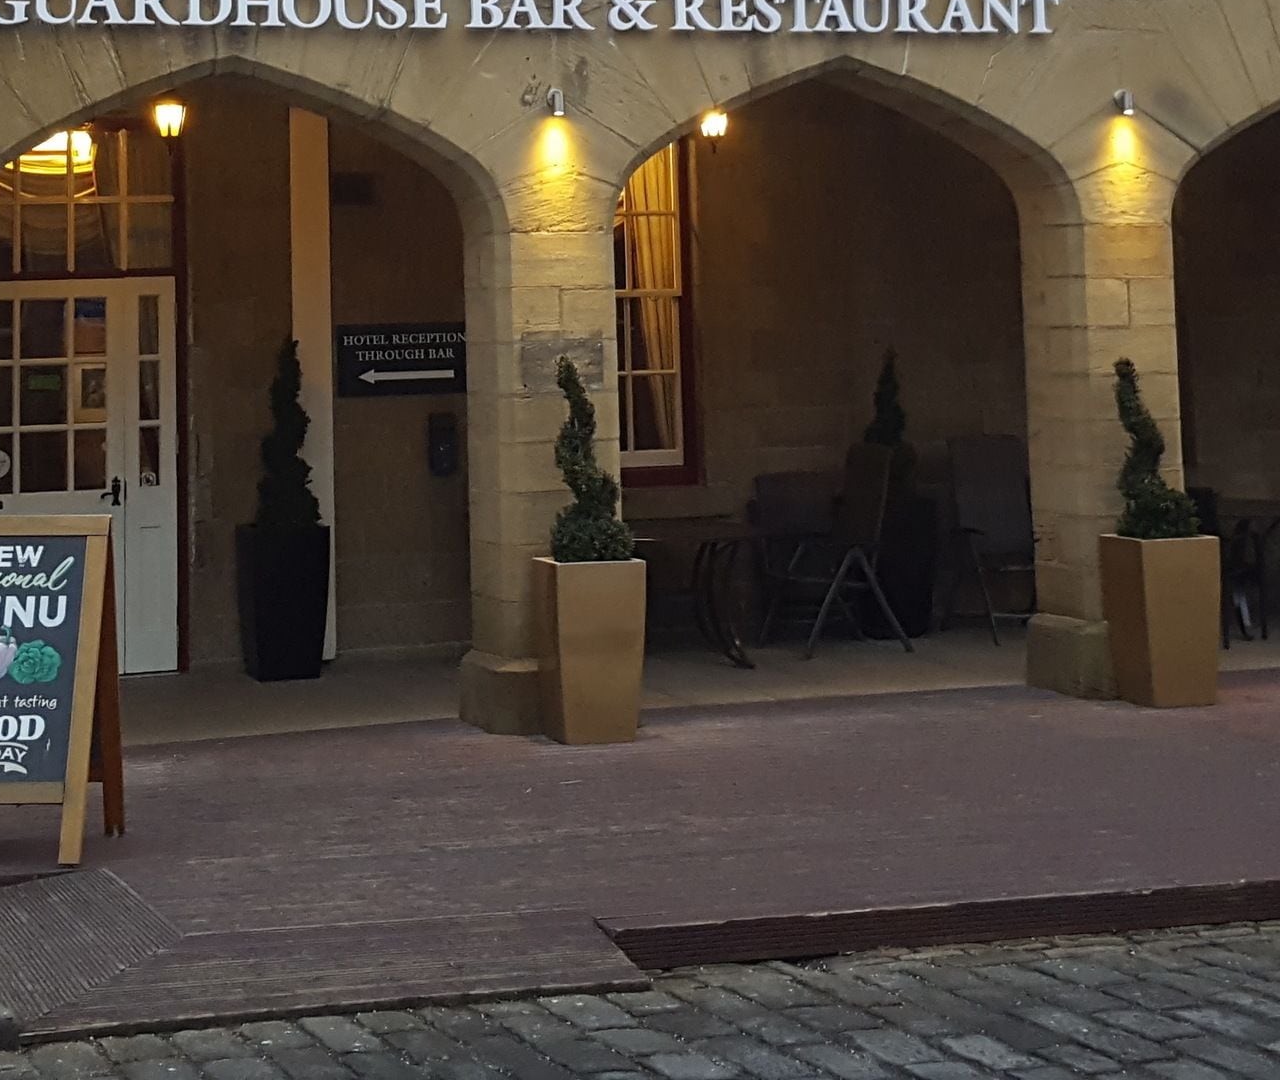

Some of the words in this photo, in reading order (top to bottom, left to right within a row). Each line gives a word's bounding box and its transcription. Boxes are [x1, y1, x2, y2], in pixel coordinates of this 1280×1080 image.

[343, 334, 389, 346] HOTEL
[392, 332, 466, 345] RECEPTION
[356, 349, 424, 361] THROUGH
[428, 348, 455, 359] BAR
[14, 694, 58, 710] tasting
